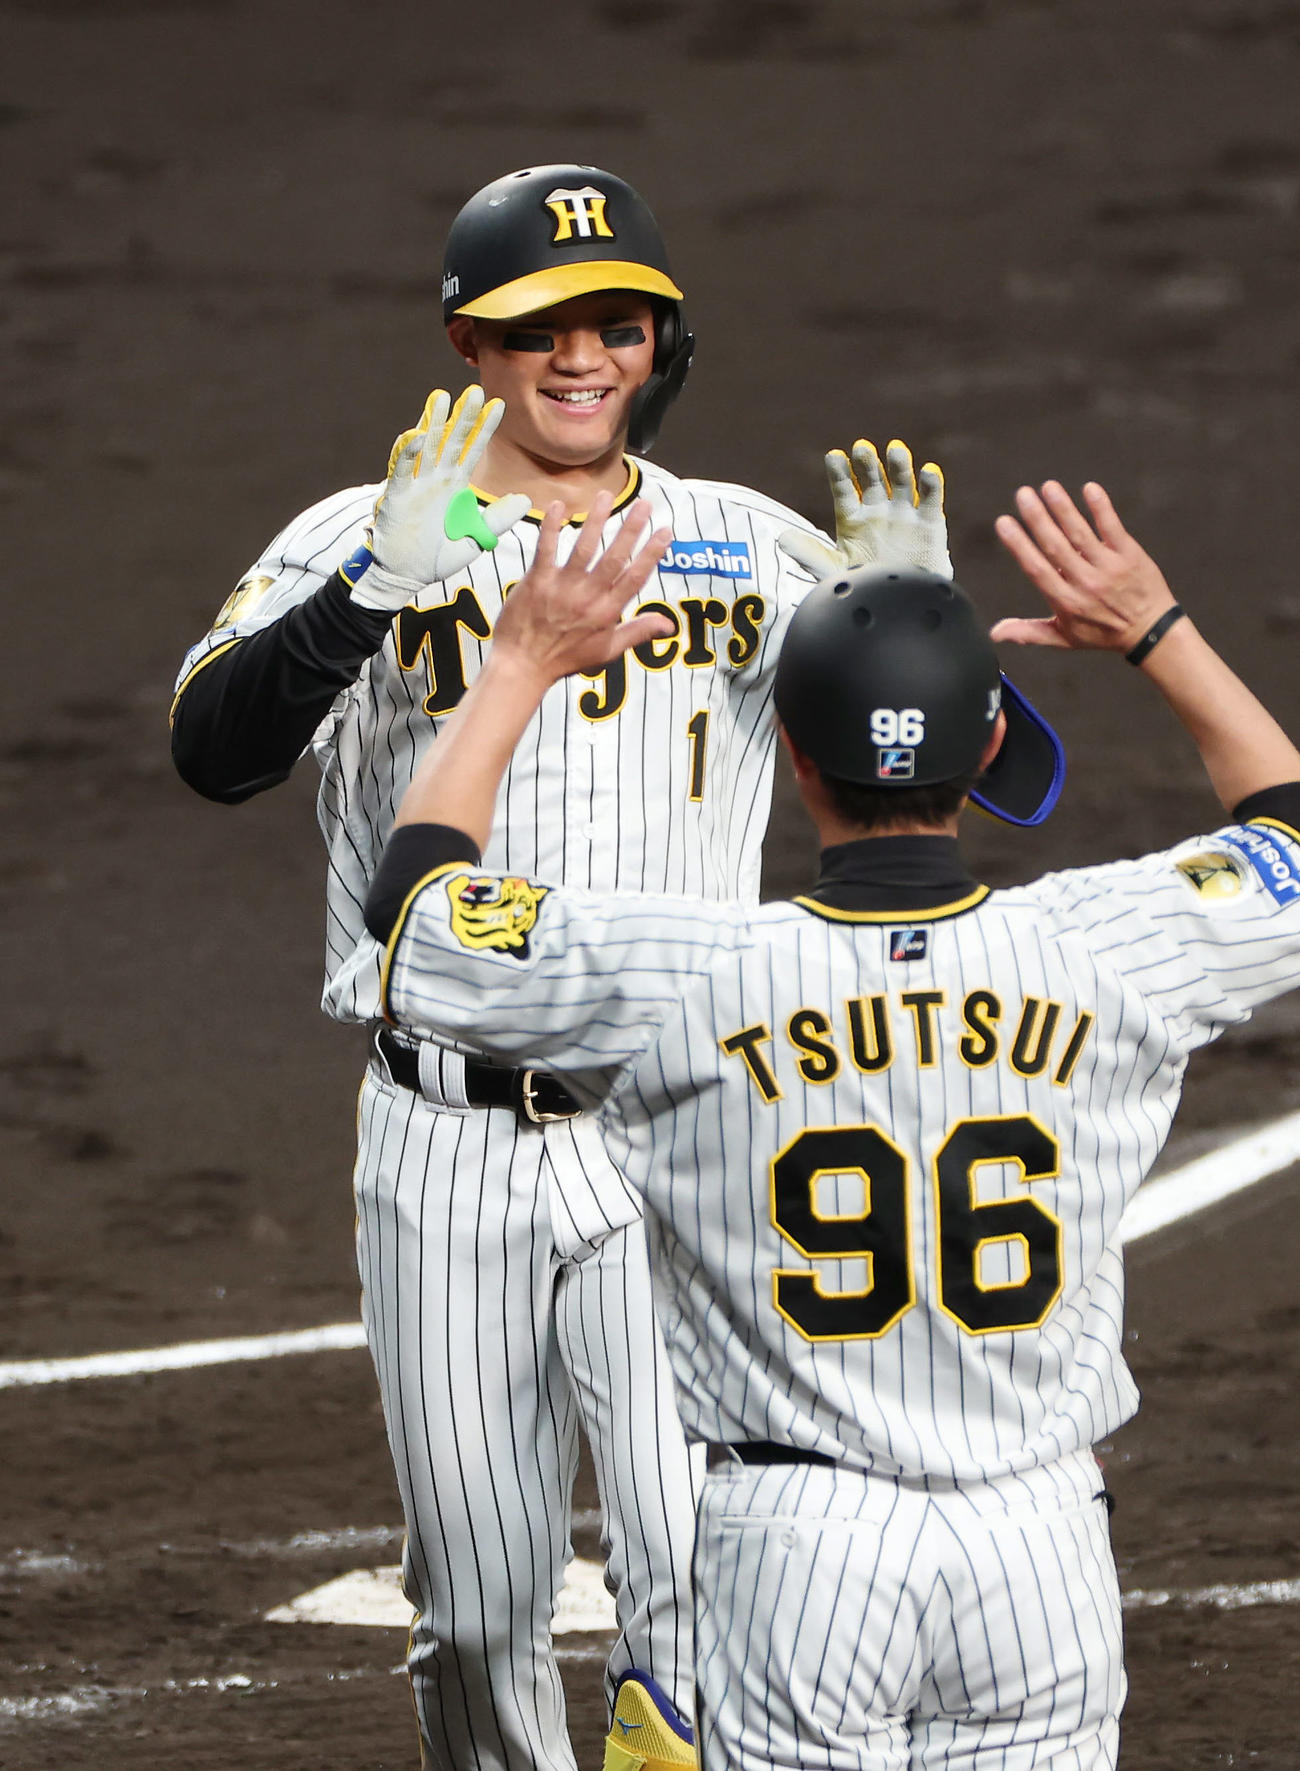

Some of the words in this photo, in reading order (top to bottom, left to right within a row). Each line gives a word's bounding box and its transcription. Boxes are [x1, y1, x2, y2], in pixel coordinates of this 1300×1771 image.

[660, 546, 751, 573] Joshin
[396, 580, 766, 722] Ters
[687, 708, 710, 802] 1
[870, 708, 925, 747] 96
[718, 989, 1096, 1104] TSUTSUI
[768, 1111, 1065, 1342] 96
